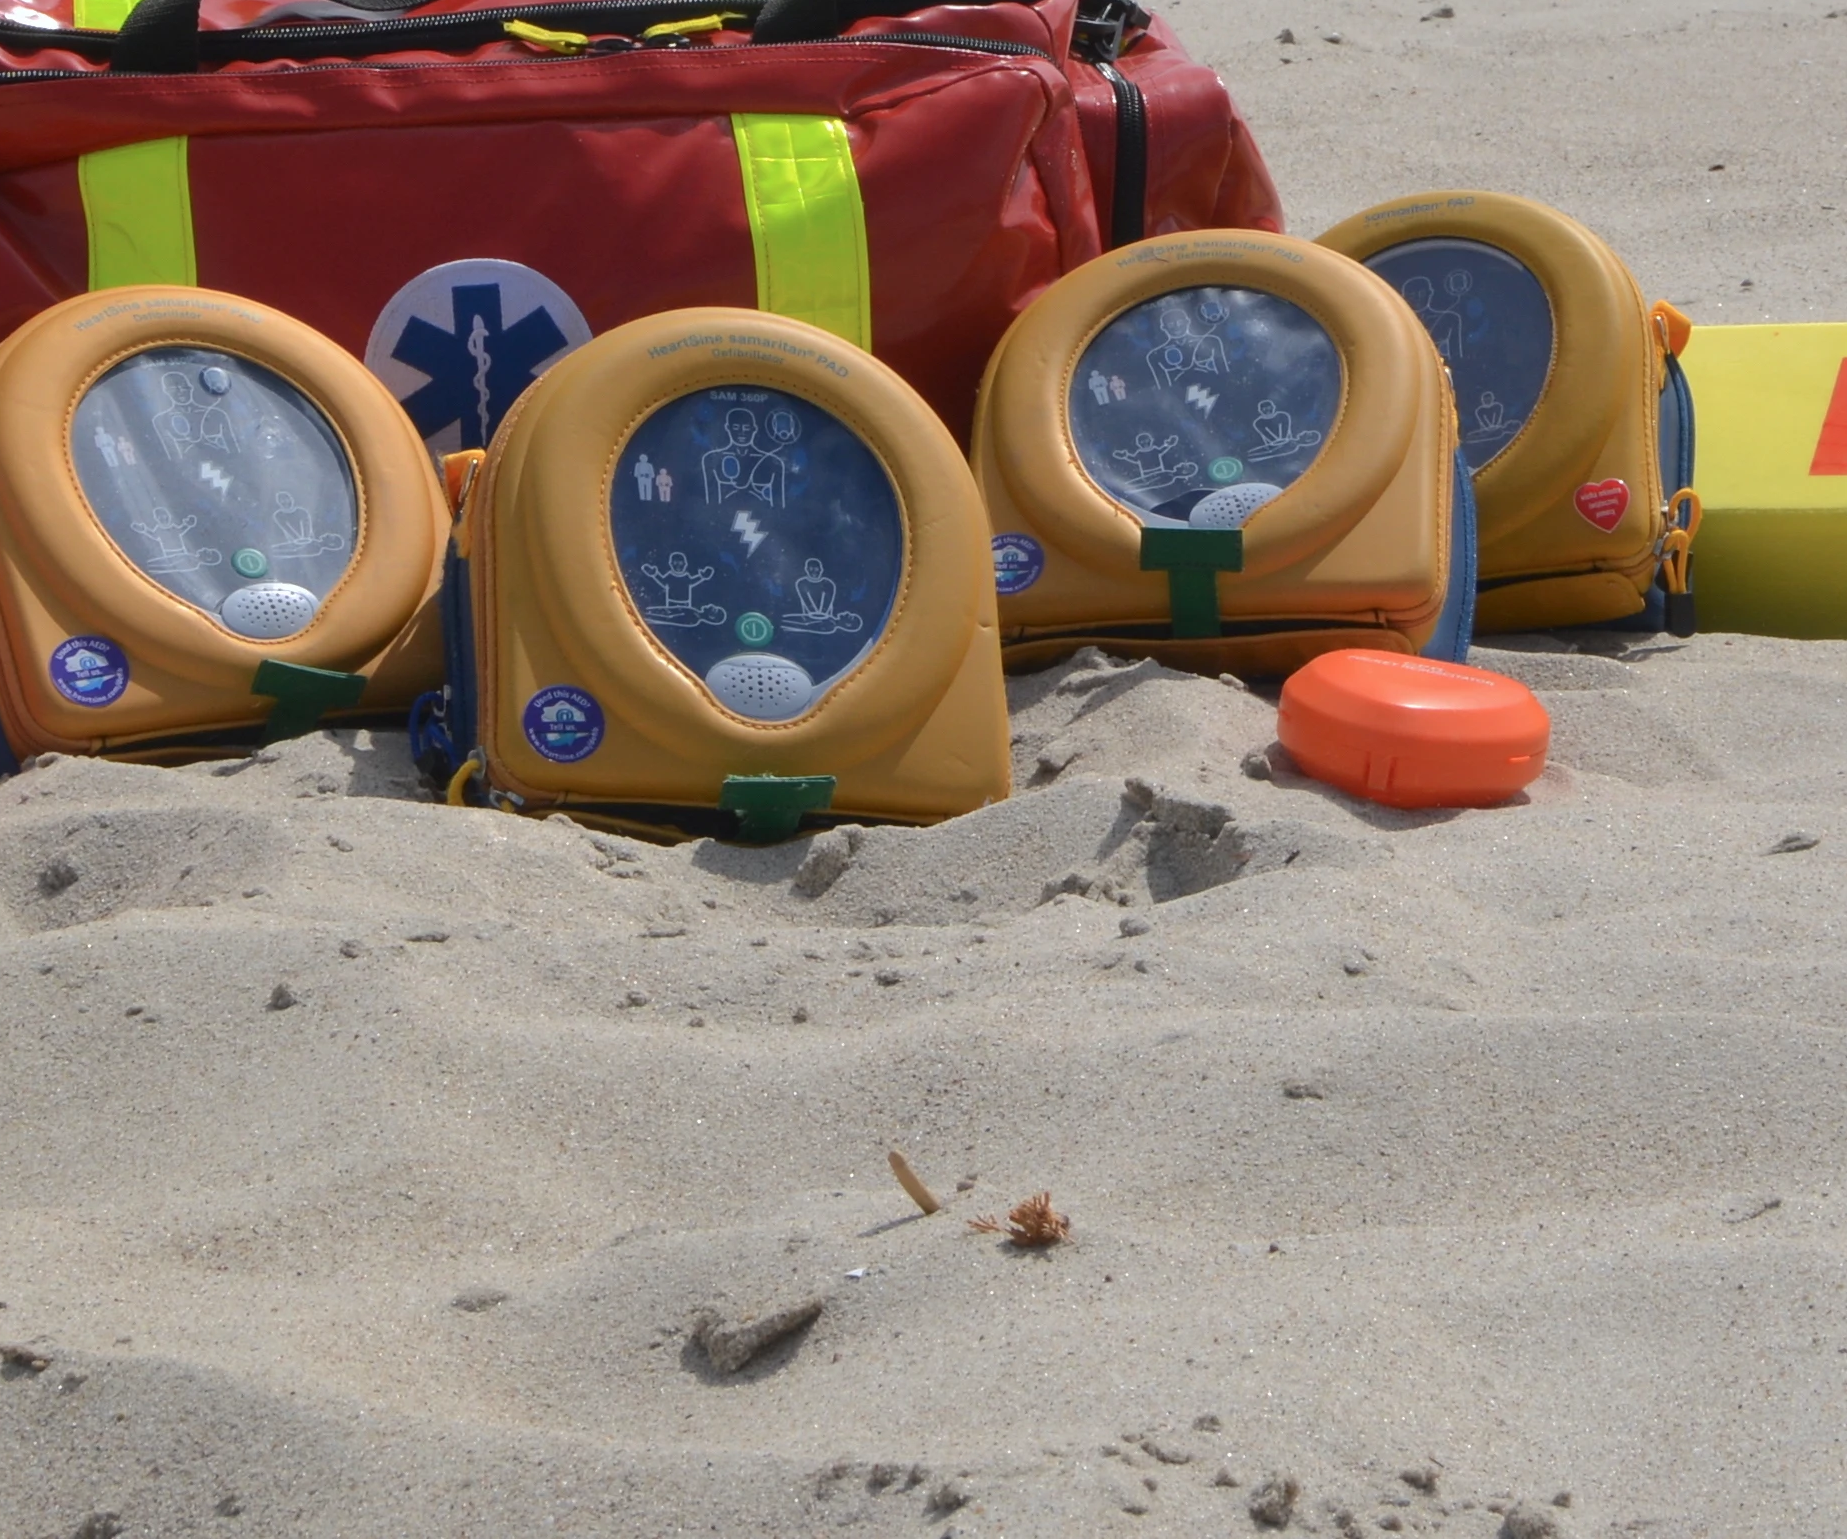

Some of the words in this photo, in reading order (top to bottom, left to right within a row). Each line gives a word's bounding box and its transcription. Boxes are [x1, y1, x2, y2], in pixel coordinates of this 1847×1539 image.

[1273, 247, 1304, 264] PAD
[73, 300, 141, 332] HeartSine
[132, 310, 201, 323] Defibrillator
[647, 334, 723, 360] HeartSine
[816, 354, 849, 379] PAD
[711, 348, 785, 365] Defibrillator
[710, 390, 737, 402] SAM
[740, 391, 769, 404] 360P
[55, 643, 72, 660] Used
[71, 640, 88, 649] this
[533, 691, 553, 708] Used
[553, 689, 570, 699] this
